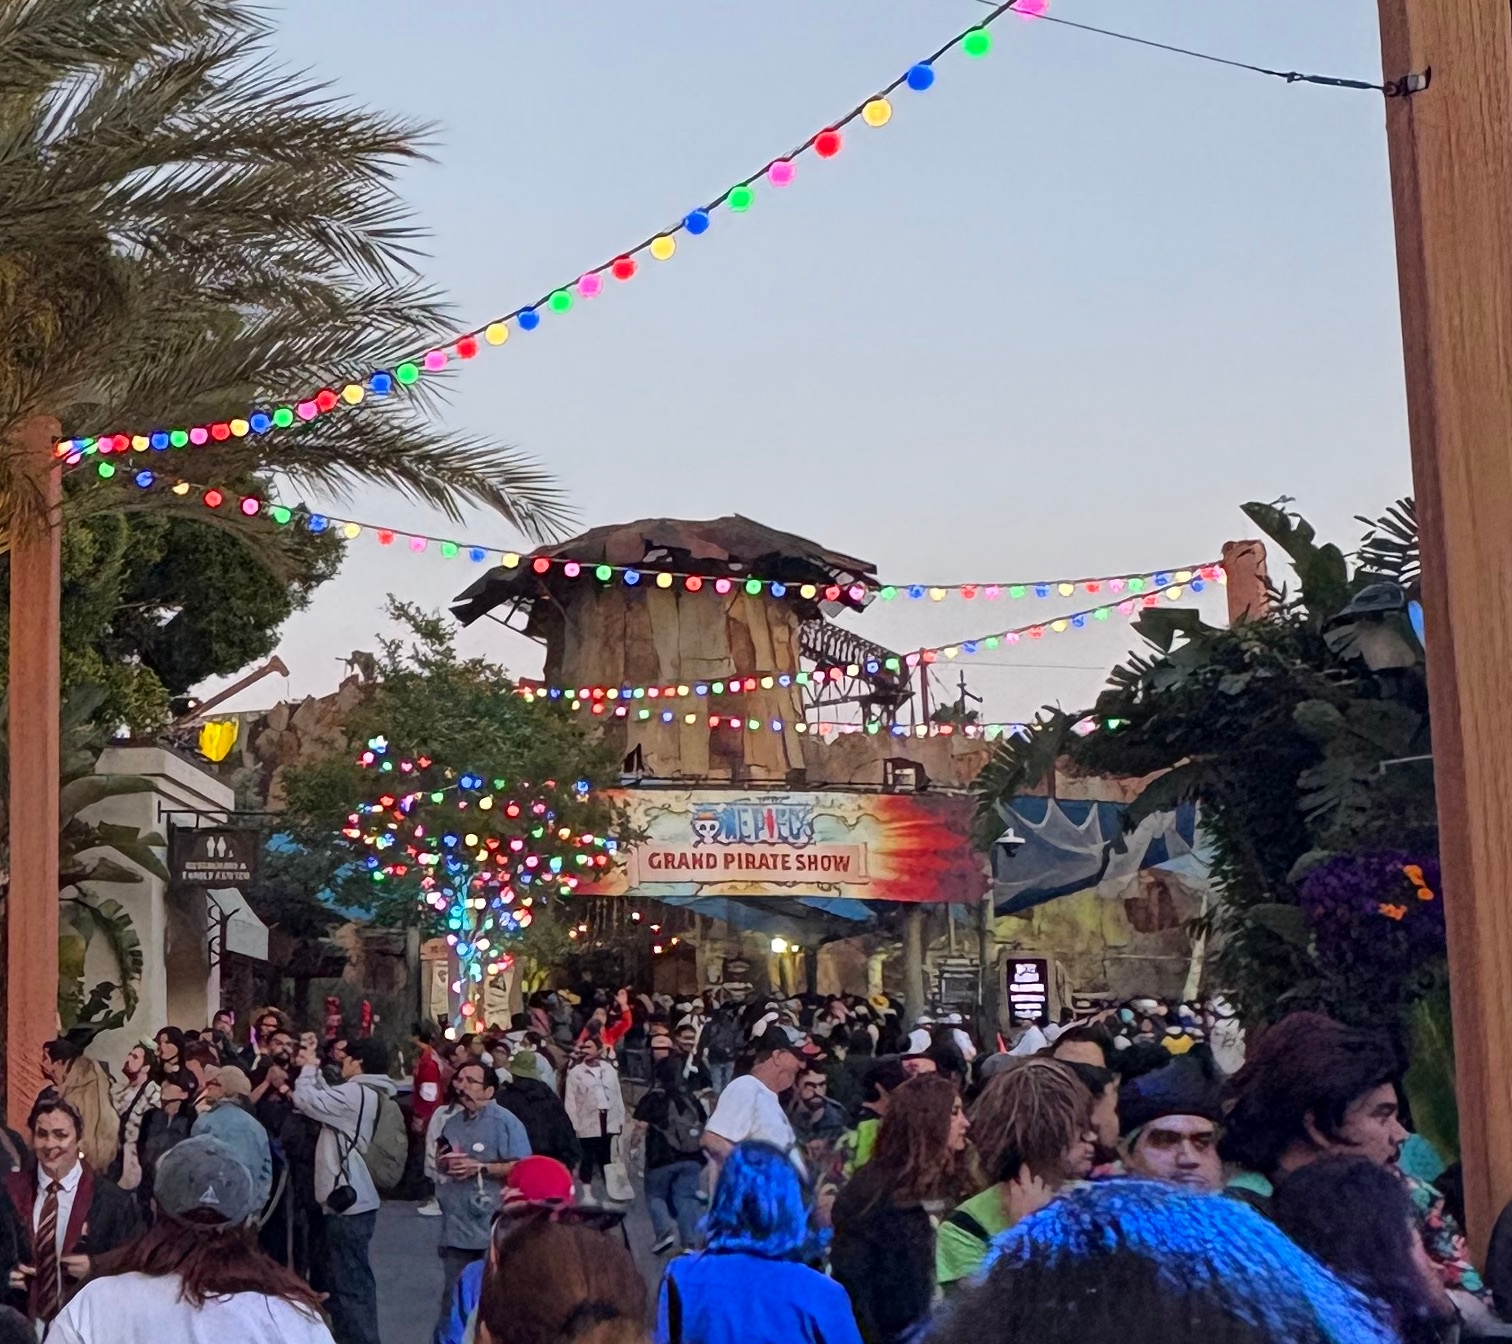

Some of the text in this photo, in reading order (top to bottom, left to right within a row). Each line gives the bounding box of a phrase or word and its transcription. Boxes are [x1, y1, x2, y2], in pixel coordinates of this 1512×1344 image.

[648, 851, 851, 873] GRAND PIRATE SHOW
